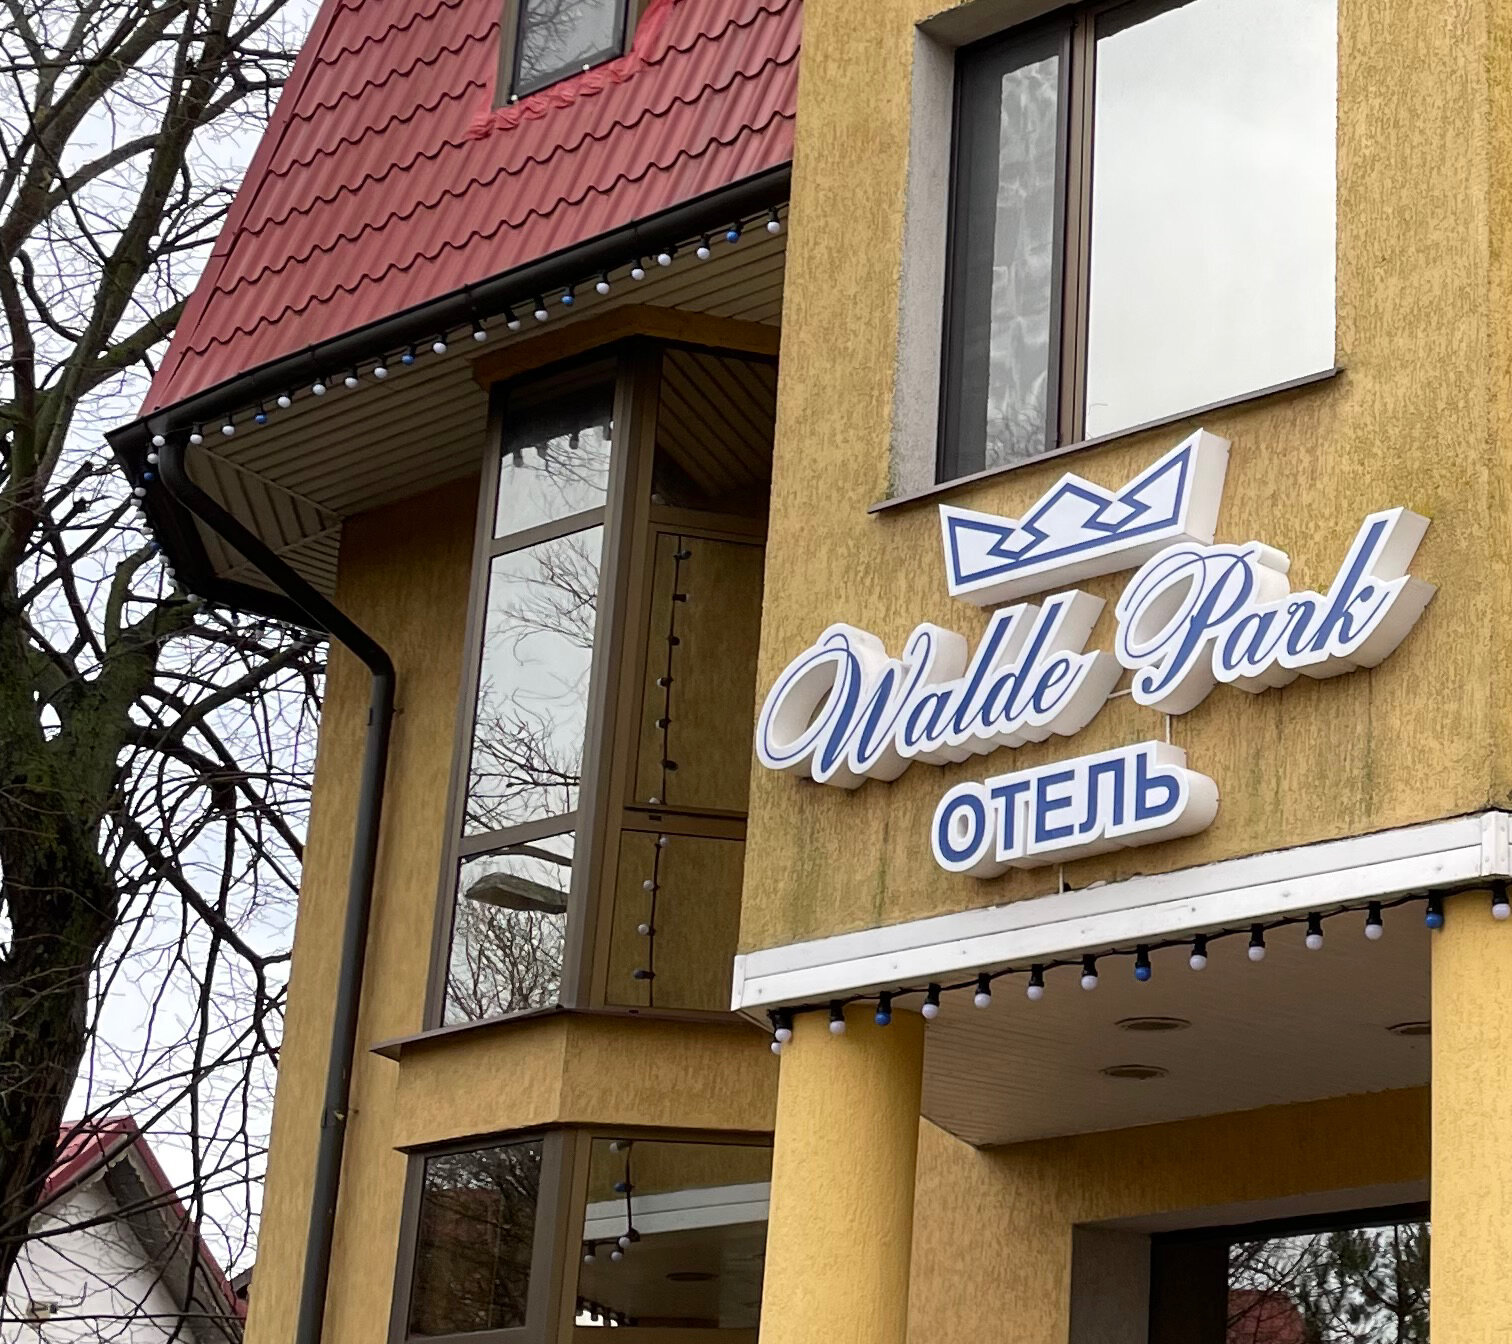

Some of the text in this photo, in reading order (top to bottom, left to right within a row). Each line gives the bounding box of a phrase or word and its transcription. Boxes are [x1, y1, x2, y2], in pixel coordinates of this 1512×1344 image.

[762, 518, 1400, 775] Walde Park
[937, 751, 1182, 864] ОТЕЛЬ
